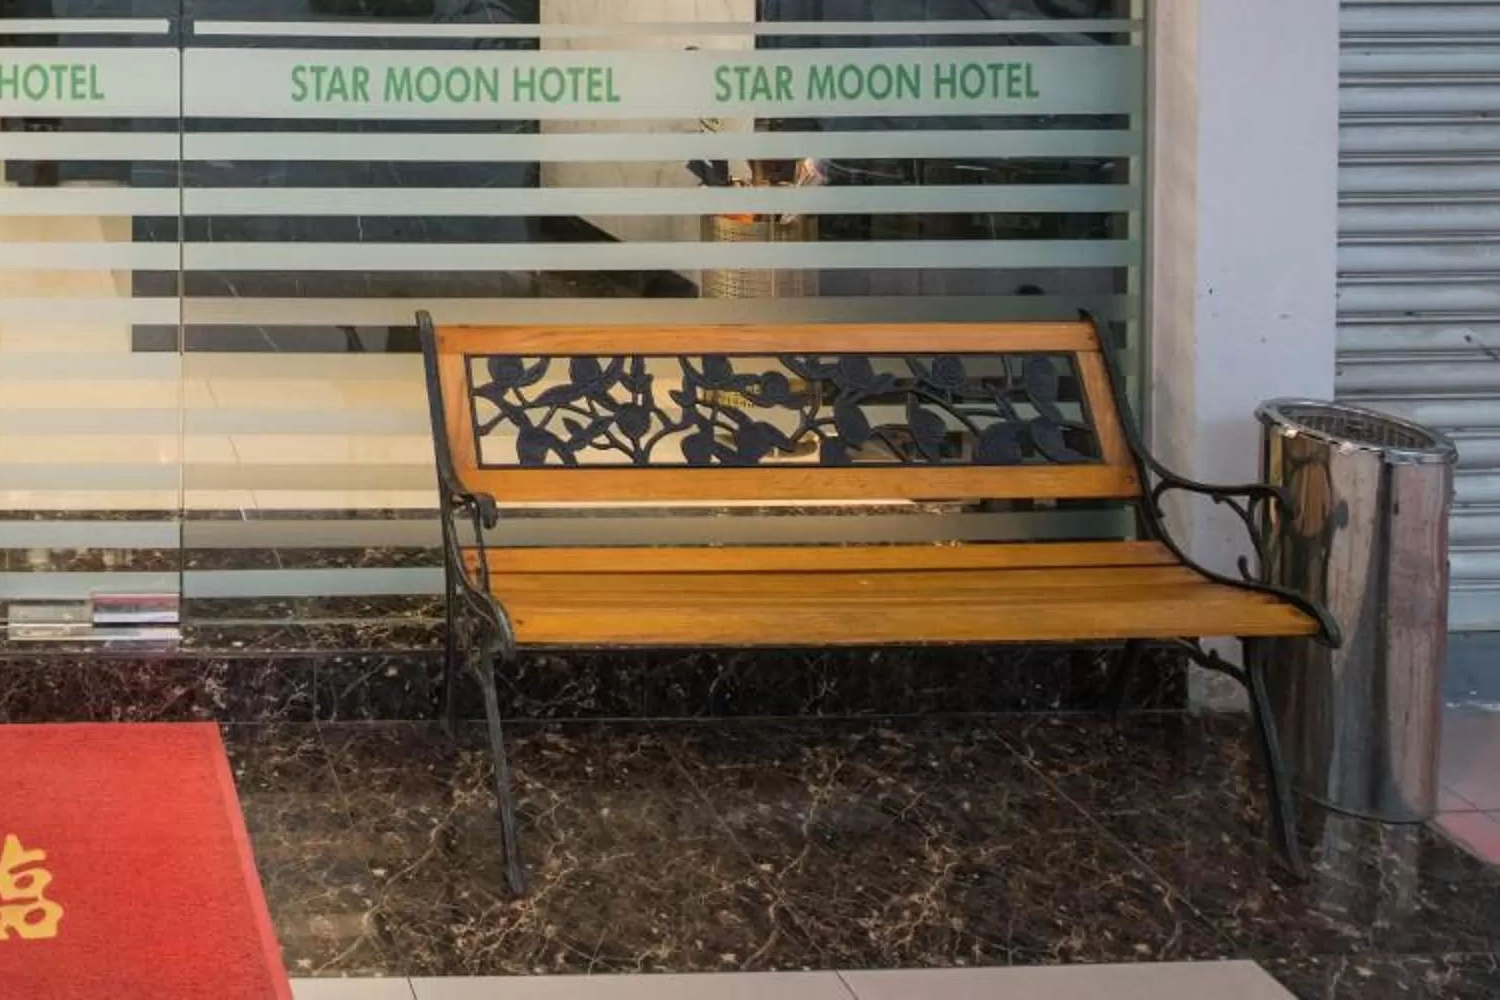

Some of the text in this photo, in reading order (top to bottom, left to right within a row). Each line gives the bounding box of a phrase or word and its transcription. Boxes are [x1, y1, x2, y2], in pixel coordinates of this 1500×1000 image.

[290, 65, 621, 103] STAR MOON HOTEL
[714, 62, 1041, 102] STAR MOON HOTEL
